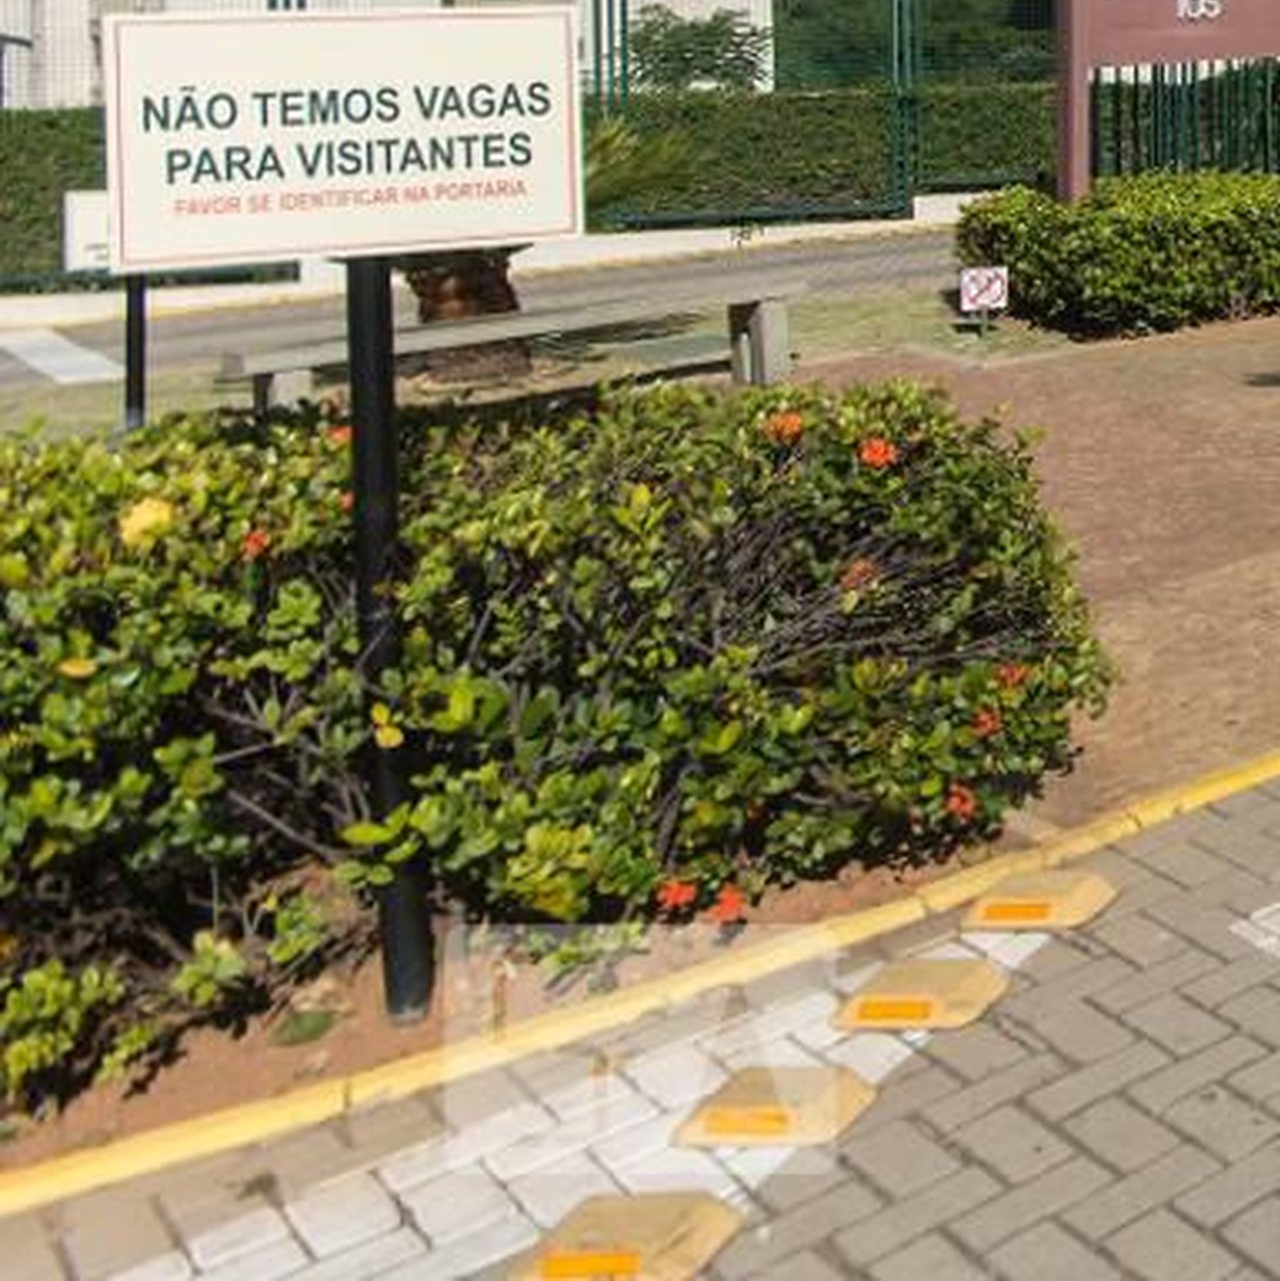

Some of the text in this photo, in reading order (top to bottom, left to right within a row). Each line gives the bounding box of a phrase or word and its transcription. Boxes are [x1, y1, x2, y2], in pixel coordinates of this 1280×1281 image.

[142, 82, 551, 131] NÃO TEMOS VAGAS
[166, 132, 532, 184] PARA VISITANTES
[174, 179, 528, 215] FAVOR SE IDENTIFICAR NA PORTARIA
